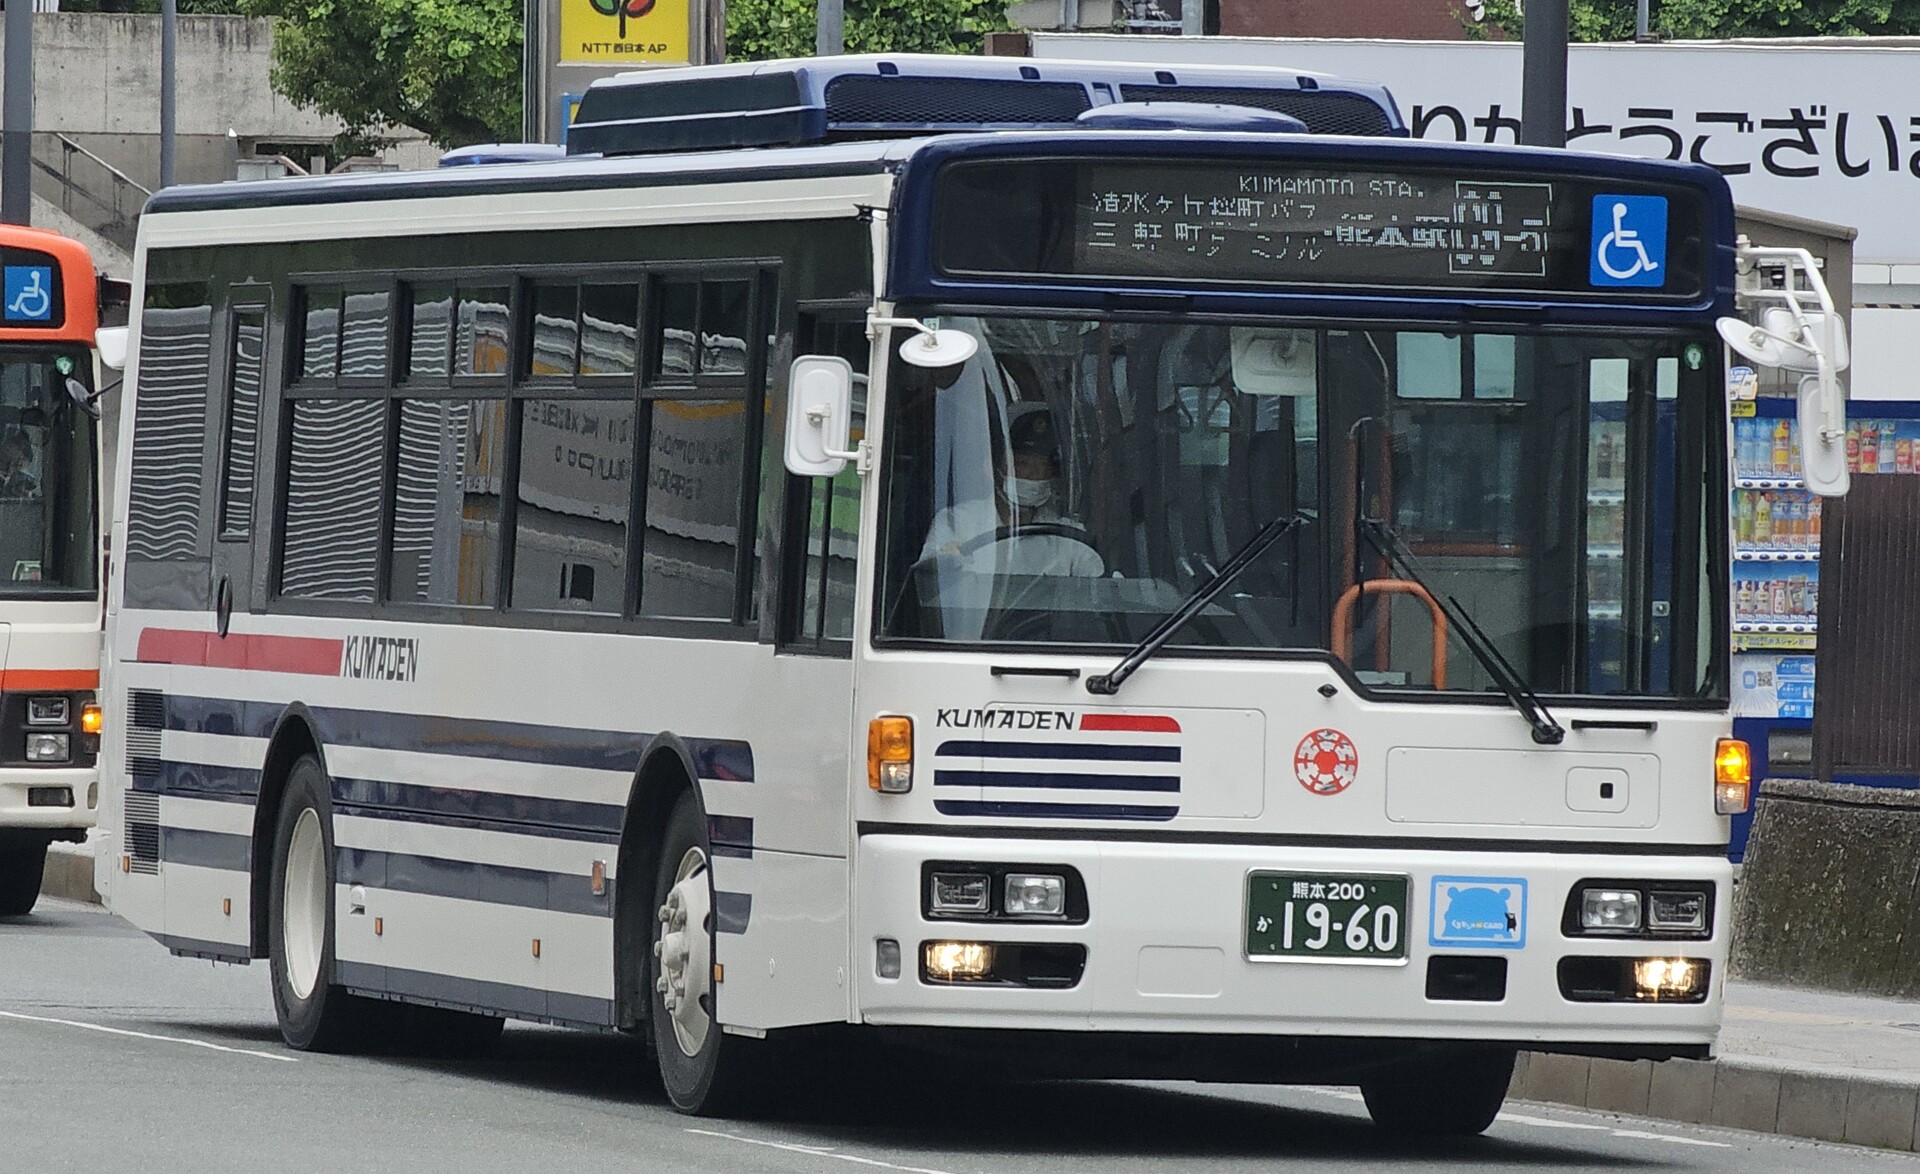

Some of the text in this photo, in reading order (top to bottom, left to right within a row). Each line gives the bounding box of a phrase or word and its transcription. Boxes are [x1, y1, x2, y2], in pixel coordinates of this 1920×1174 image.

[343, 635, 419, 682] KUMADEN
[935, 709, 1075, 731] KUMADEN
[1256, 901, 1398, 951] か 19-60
